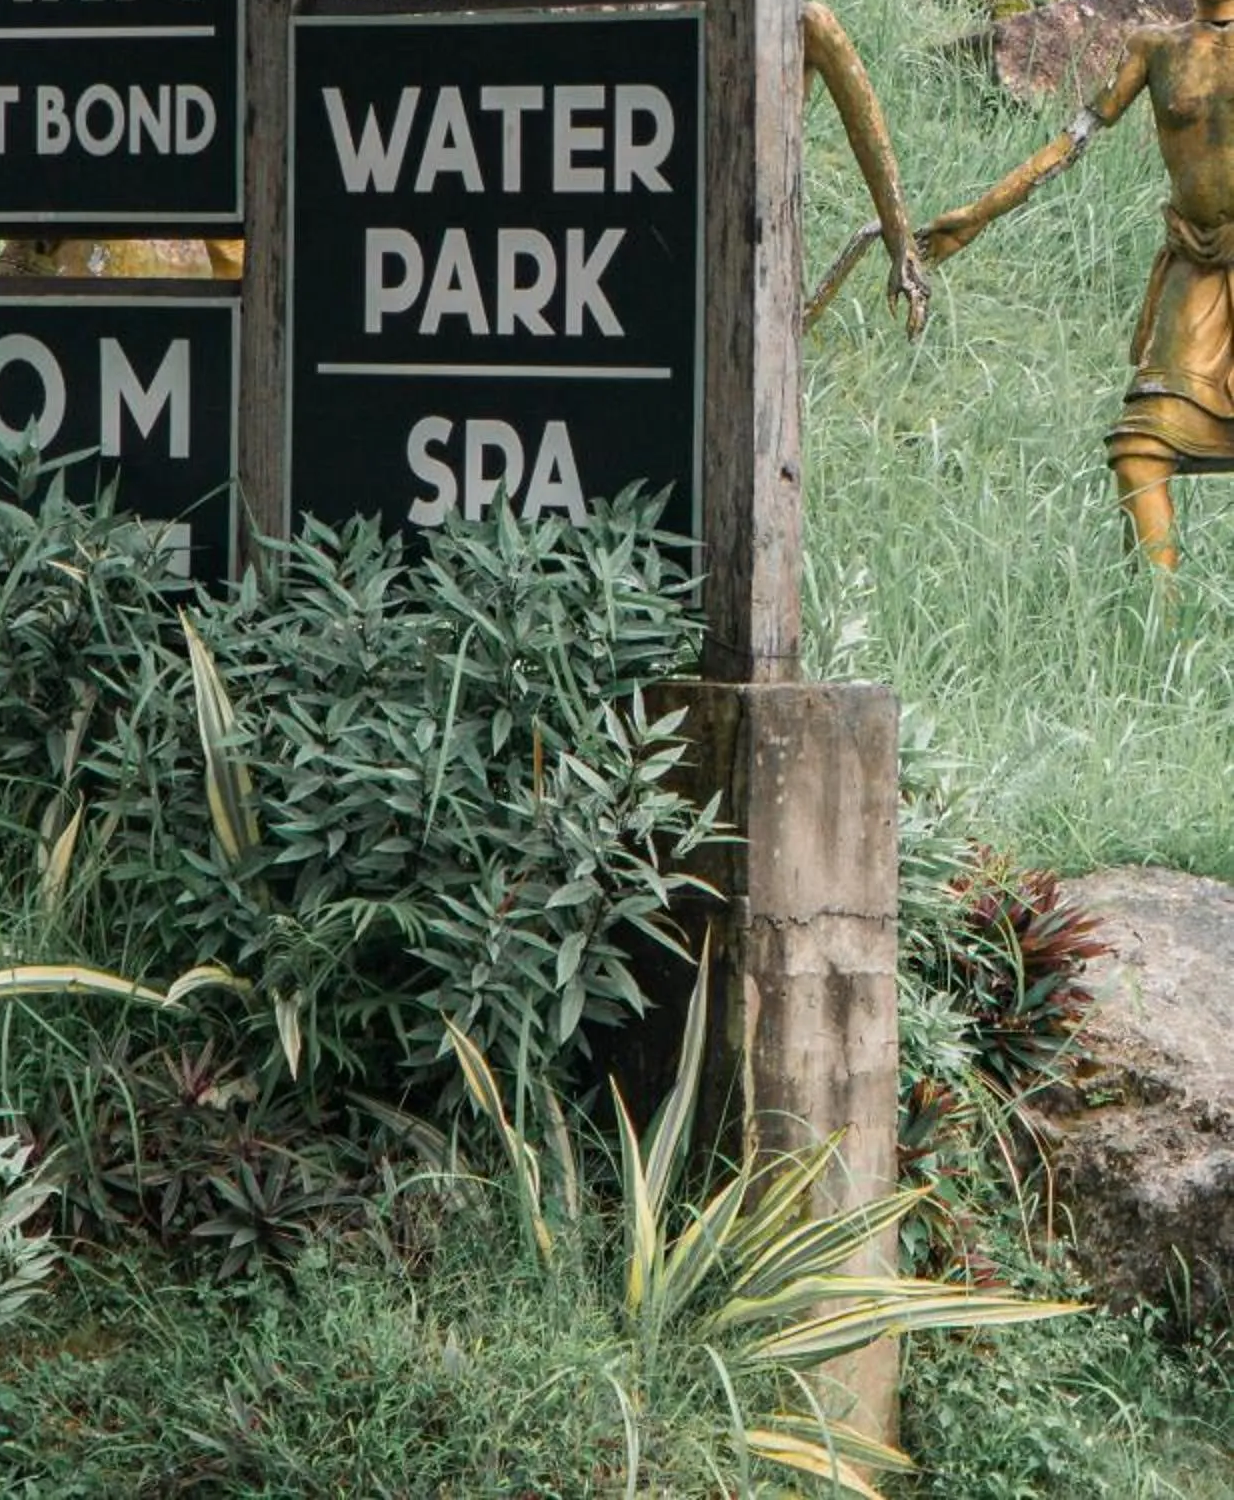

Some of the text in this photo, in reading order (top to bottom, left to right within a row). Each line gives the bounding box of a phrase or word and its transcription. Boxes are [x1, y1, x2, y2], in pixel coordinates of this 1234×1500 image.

[35, 83, 217, 157] BOND
[320, 84, 675, 196] WATER
[362, 227, 626, 337] PARK
[99, 336, 191, 459] M
[405, 414, 590, 528] SPA
